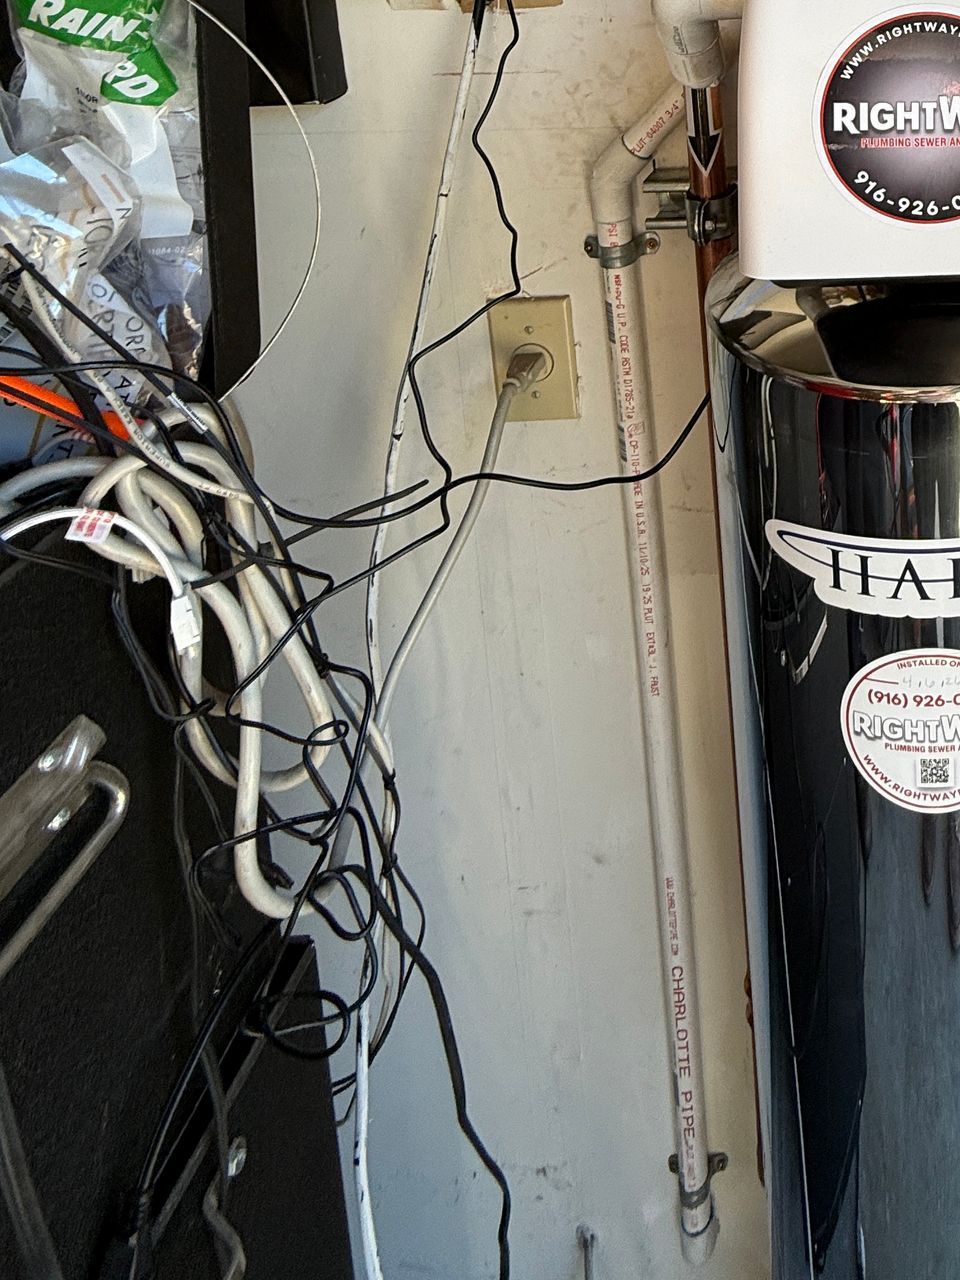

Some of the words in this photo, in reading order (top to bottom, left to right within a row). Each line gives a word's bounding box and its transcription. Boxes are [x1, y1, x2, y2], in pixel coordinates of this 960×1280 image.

[861, 137, 911, 148] PLUMBING
[914, 137, 947, 147] SEWER
[897, 659, 947, 669] INSTALLED
[867, 688, 909, 708] (916)
[884, 742, 926, 753] PLUMBING
[928, 742, 956, 753] SEWER
[672, 966, 691, 1078] CHARLOTTE
[682, 1090, 695, 1138] PIPE
